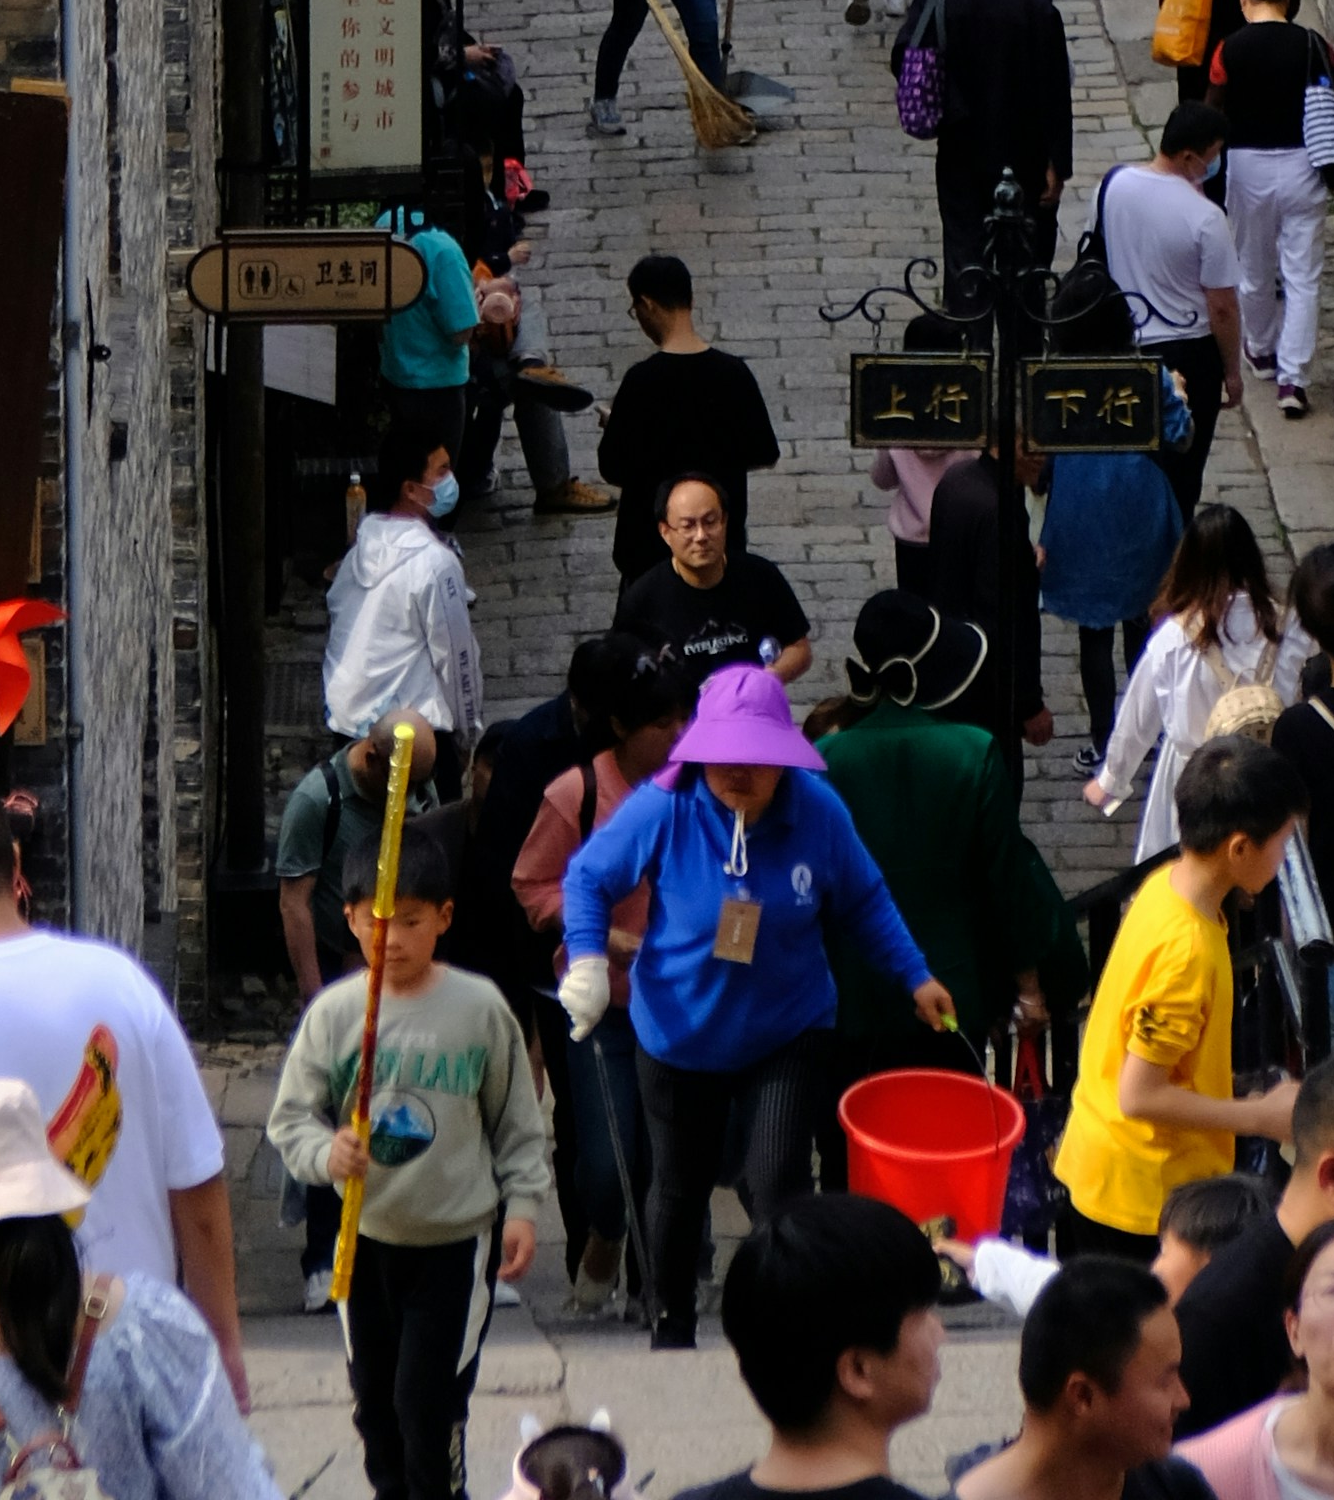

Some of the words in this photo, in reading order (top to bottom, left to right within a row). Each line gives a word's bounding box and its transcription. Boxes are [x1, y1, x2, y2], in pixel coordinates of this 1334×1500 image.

[315, 260, 379, 287] 卫生间
[873, 384, 969, 424] 上行
[1044, 386, 1140, 429] 下行
